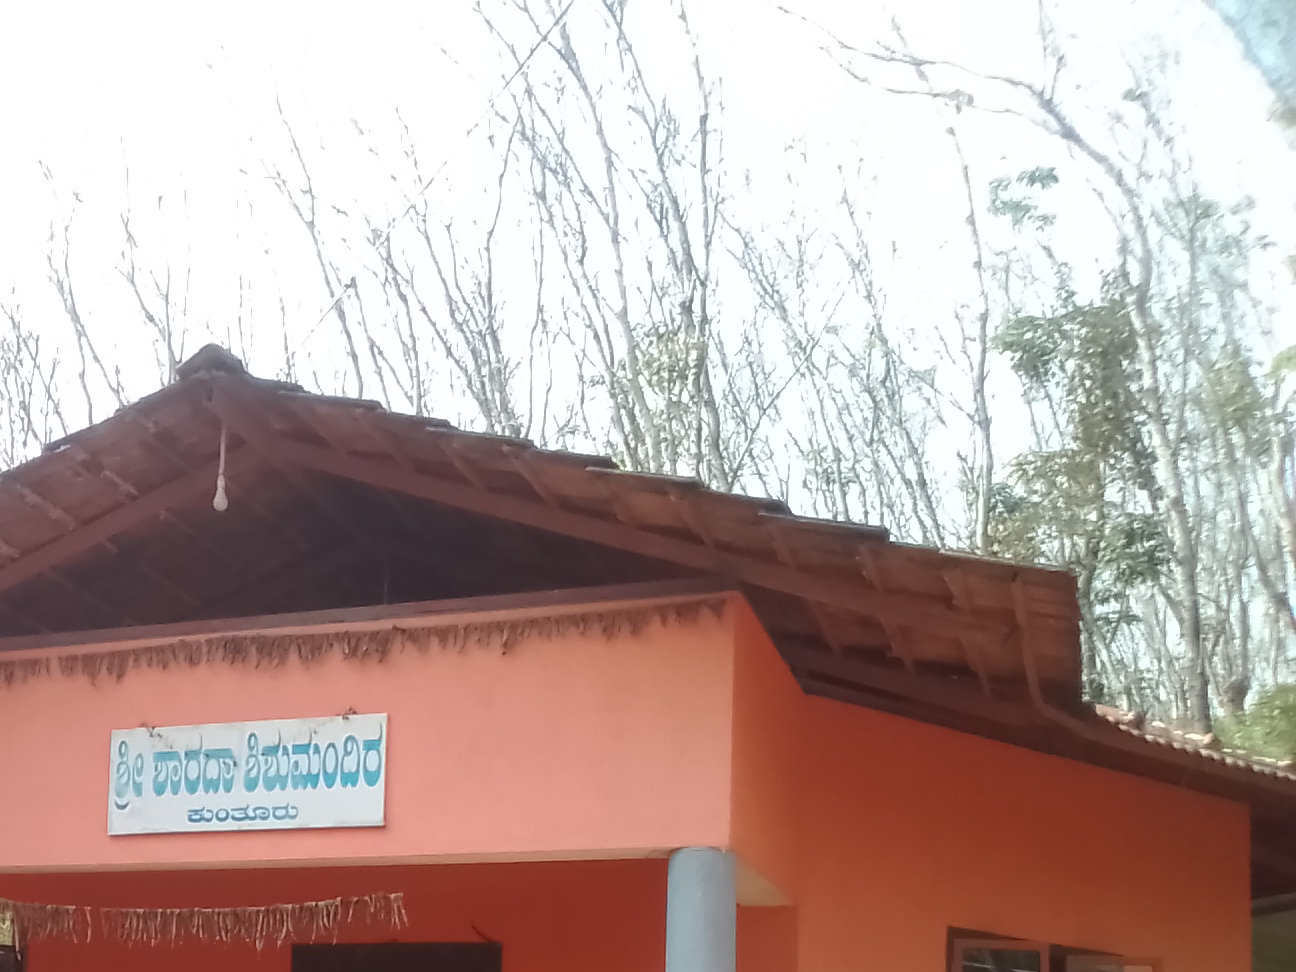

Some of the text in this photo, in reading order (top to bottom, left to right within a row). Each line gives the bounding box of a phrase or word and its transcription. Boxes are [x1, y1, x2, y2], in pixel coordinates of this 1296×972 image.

[114, 723, 383, 811] ಶ್ರೀ ಶಾರದಾ ಶಿಶುಮಂದಿರ
[187, 803, 299, 824] ಕುಂತೂರು
